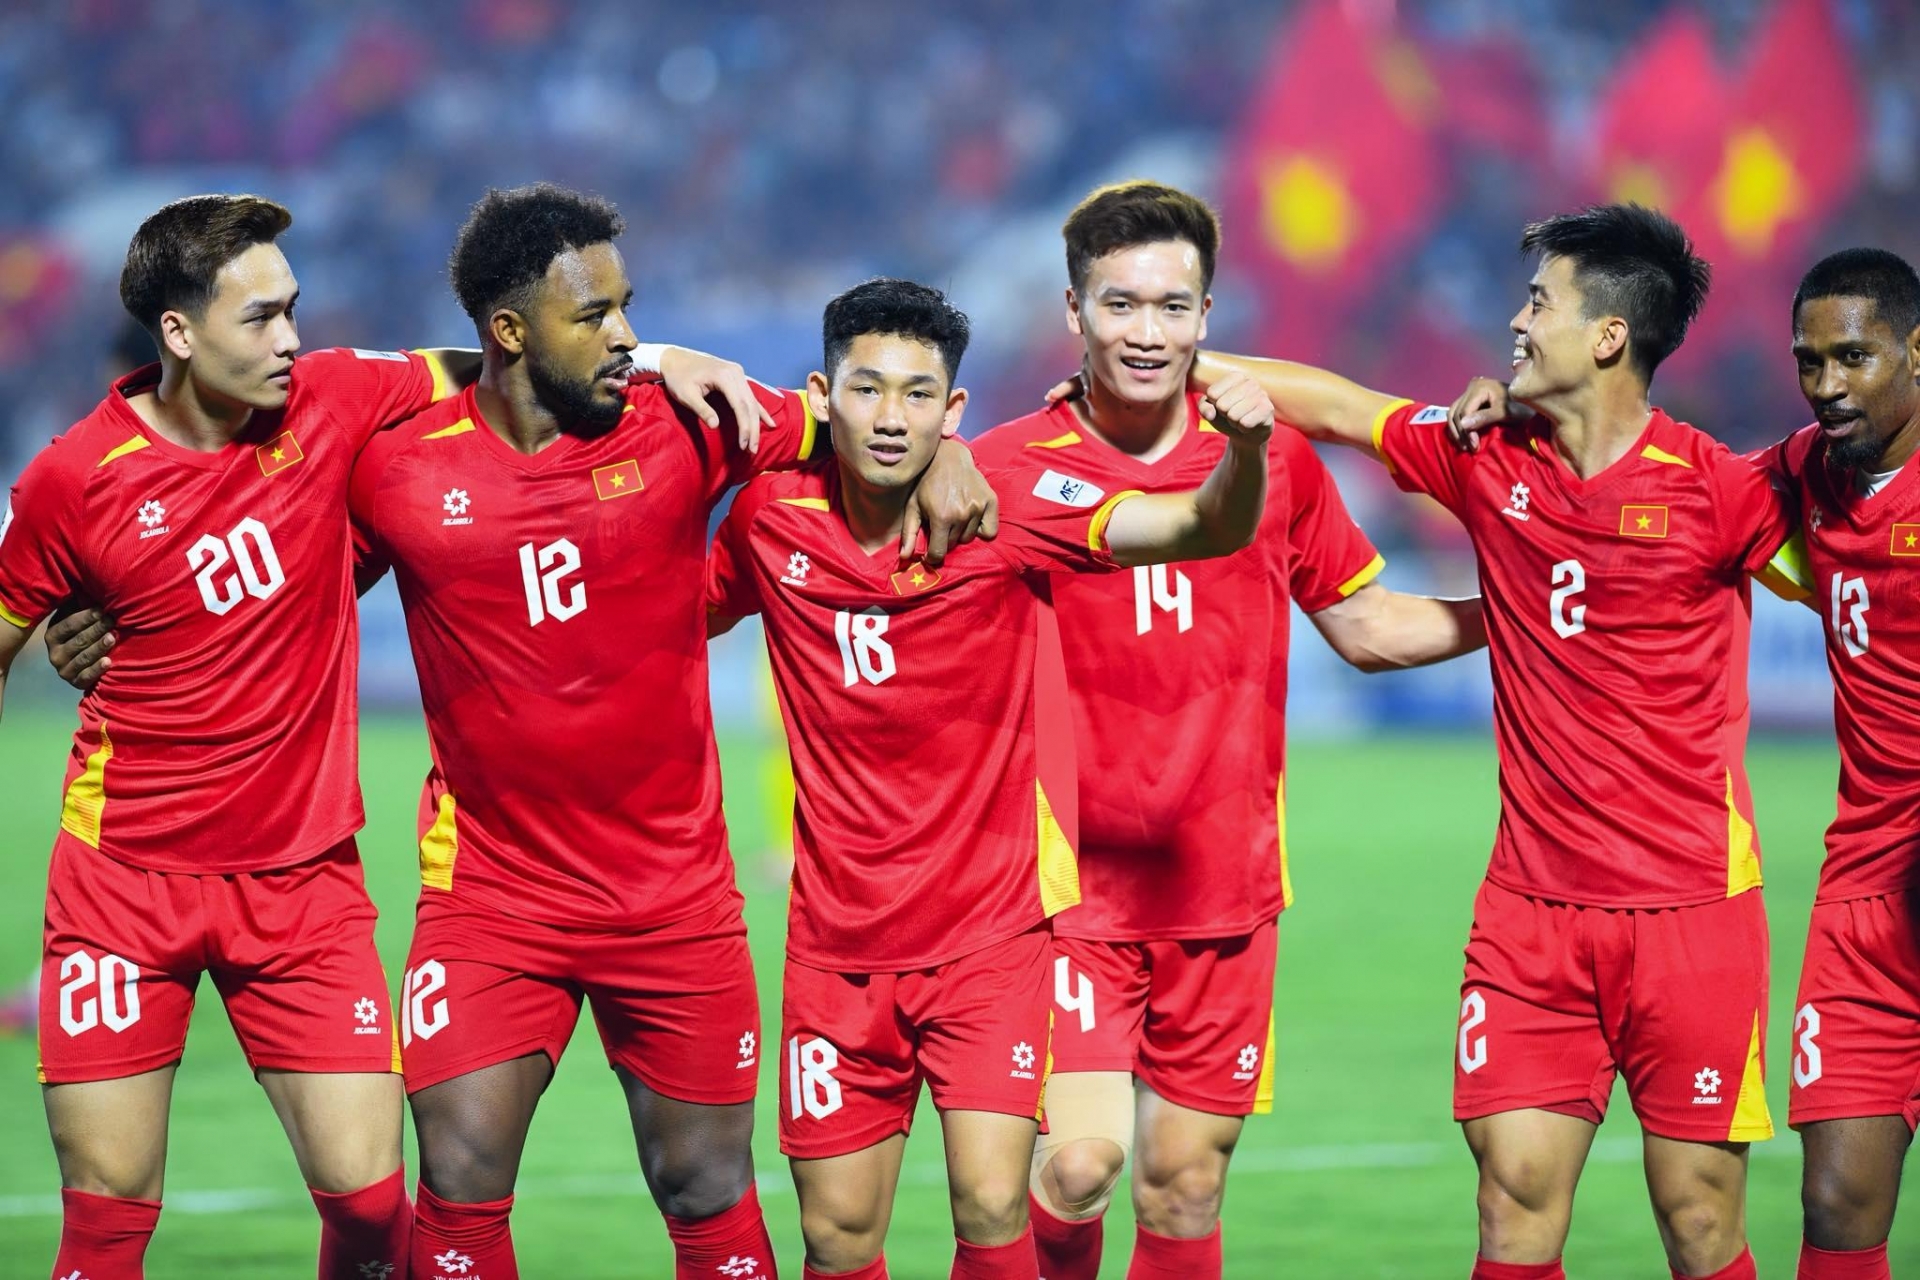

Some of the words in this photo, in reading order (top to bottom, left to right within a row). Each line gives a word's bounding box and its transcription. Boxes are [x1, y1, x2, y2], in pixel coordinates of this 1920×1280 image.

[1060, 479, 1080, 501] AFC
[186, 516, 286, 616] 20
[518, 537, 588, 627] 12
[1133, 564, 1194, 636] 14
[1549, 559, 1587, 639] 2
[834, 605, 897, 688] 18
[1831, 571, 1870, 659] 13
[60, 949, 141, 1038] 20
[401, 958, 451, 1050] 12
[1457, 990, 1488, 1075] 2
[788, 1035, 844, 1121] 18
